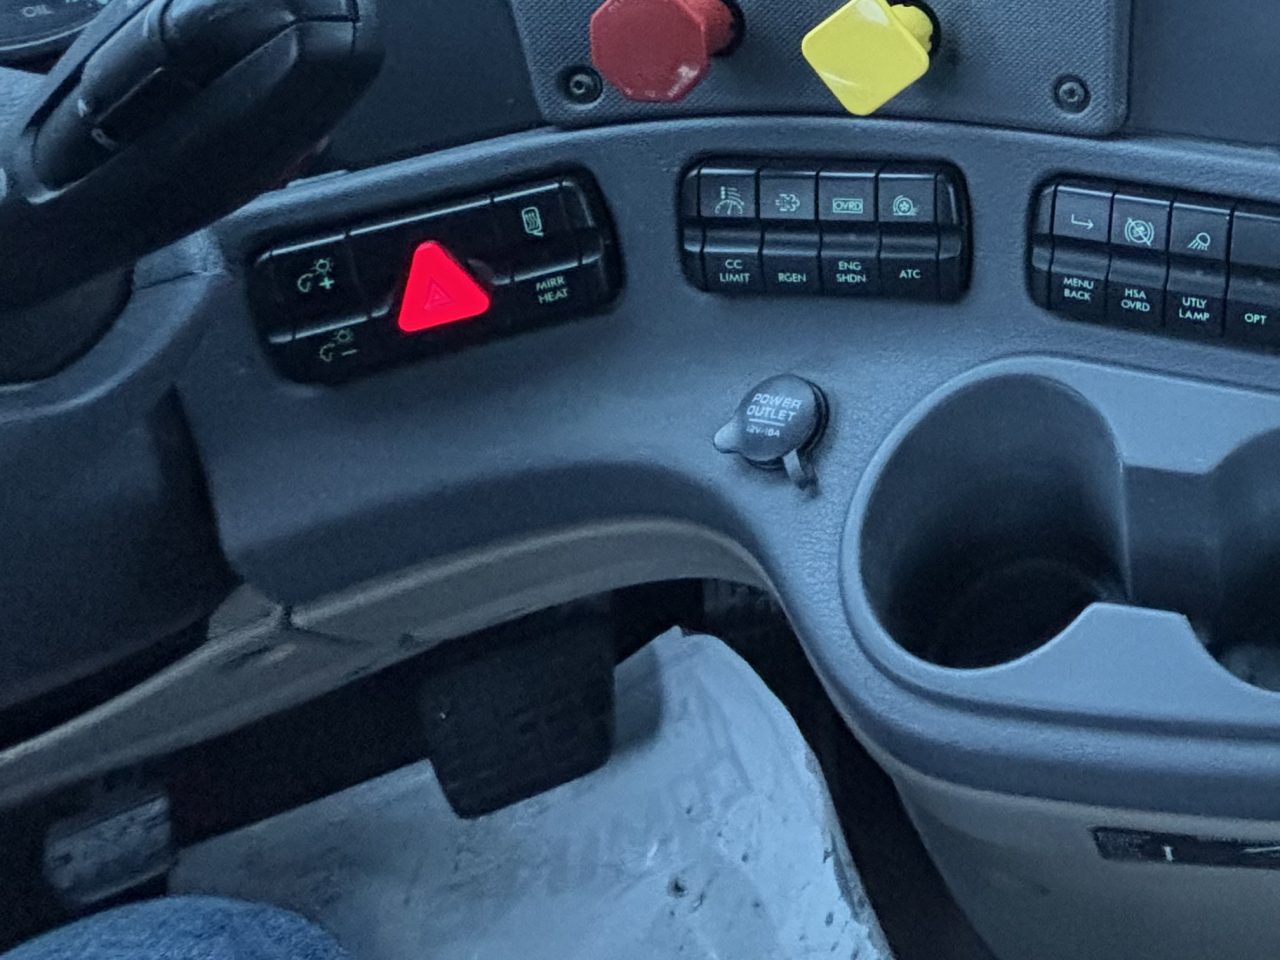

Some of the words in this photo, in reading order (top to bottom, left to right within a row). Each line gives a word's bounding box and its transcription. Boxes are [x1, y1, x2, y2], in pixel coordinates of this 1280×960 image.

[834, 200, 862, 212] OVRD
[725, 259, 743, 269] CC
[838, 261, 862, 271] ENG
[719, 273, 750, 283] LIMIT
[777, 272, 807, 283] RGEN
[836, 273, 866, 283] SHDN
[899, 269, 921, 279] ATC
[536, 276, 566, 291] MIRR
[1063, 277, 1094, 290] MENU
[538, 287, 569, 304] HEAT
[1063, 289, 1092, 301] BACK
[1124, 288, 1146, 300] HSA
[1121, 300, 1150, 312] OVRD
[1182, 297, 1207, 309] UTLY
[1179, 309, 1210, 321] LAMP
[1244, 313, 1267, 325] OPT
[752, 393, 803, 409] POWER
[746, 405, 797, 421] OUTLET
